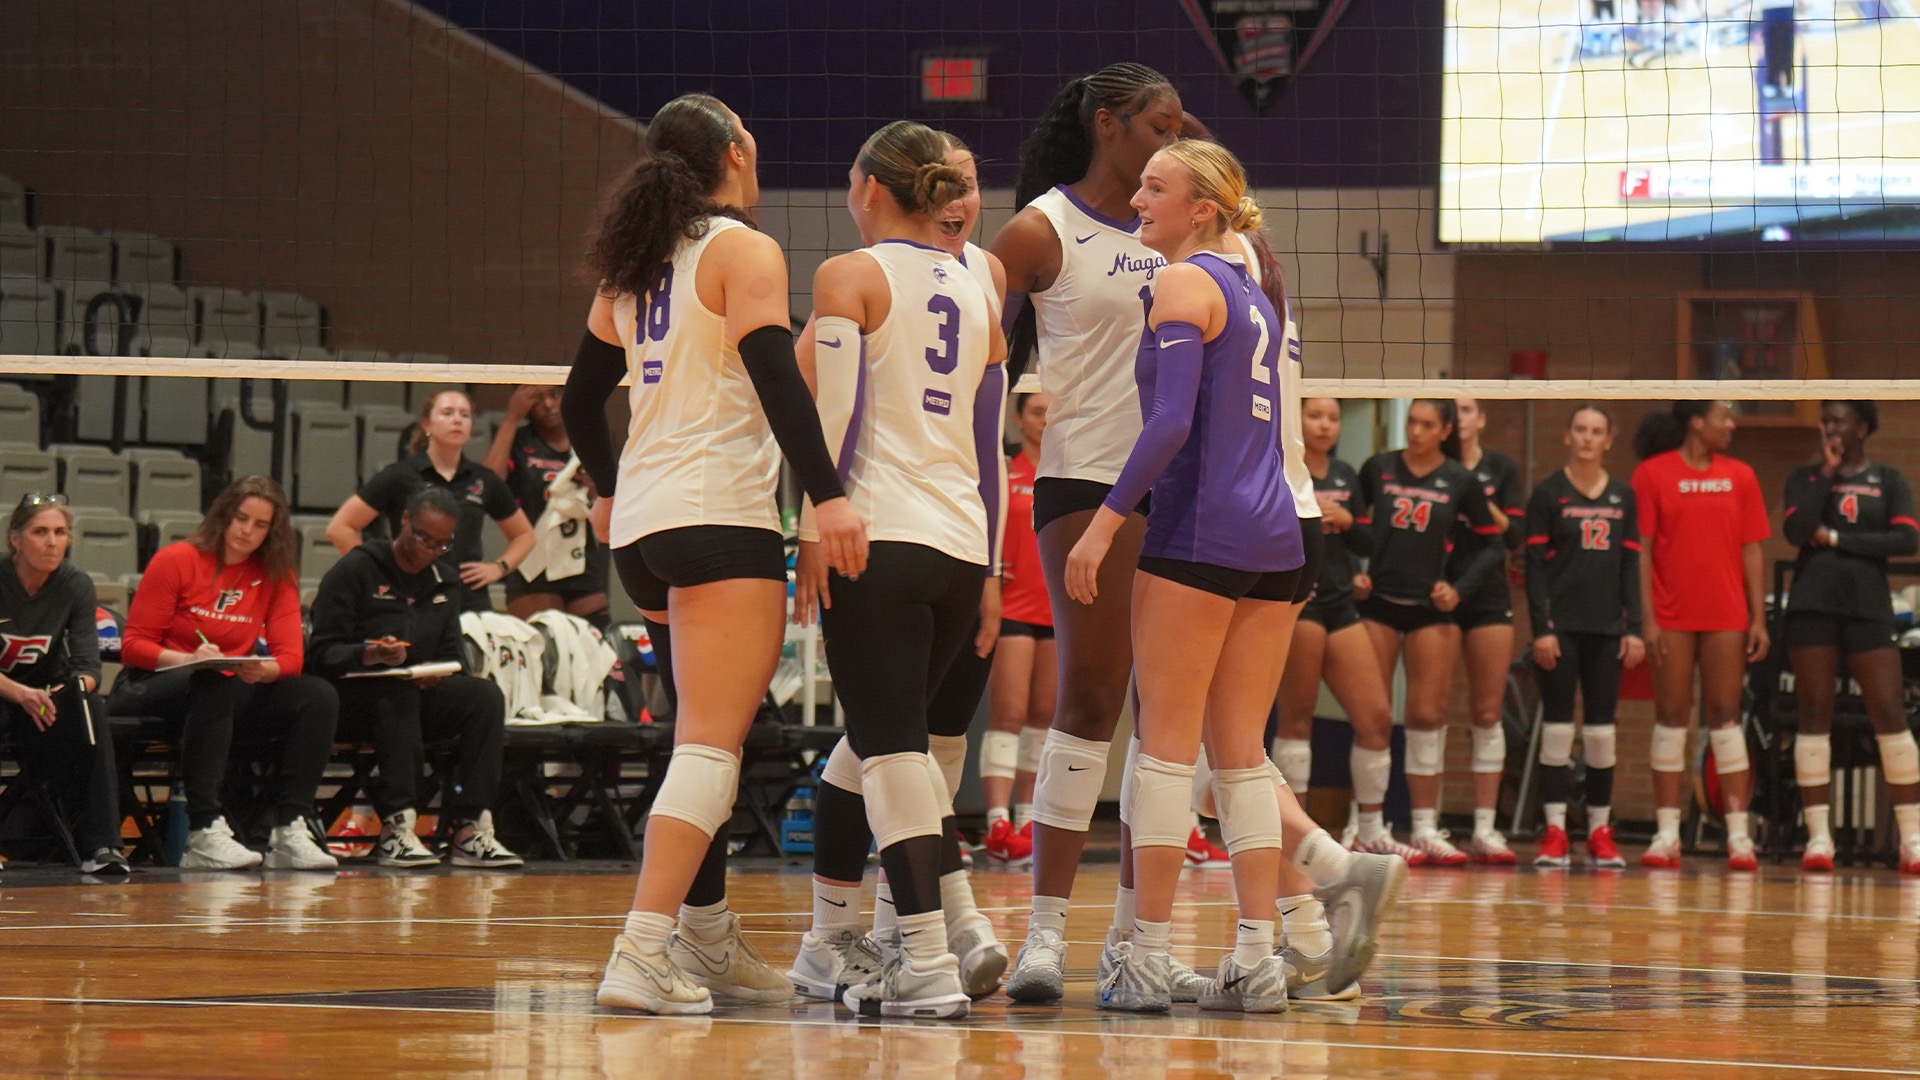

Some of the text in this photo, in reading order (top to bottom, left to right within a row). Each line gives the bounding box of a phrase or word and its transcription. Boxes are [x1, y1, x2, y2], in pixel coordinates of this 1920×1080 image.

[1107, 252, 1169, 280] Niaga
[635, 260, 675, 345] 18
[925, 293, 960, 375] 3
[1249, 304, 1271, 385] 2
[925, 394, 950, 408] METRO
[1254, 401, 1270, 415] METRO
[1678, 478, 1733, 494] STAGS
[1391, 497, 1433, 533] 24
[1838, 491, 1858, 524] 4
[1580, 518, 1610, 550] 12
[571, 547, 585, 560] G
[213, 589, 244, 613] F
[0, 632, 53, 674] F
[98, 637, 121, 650] EPSI
